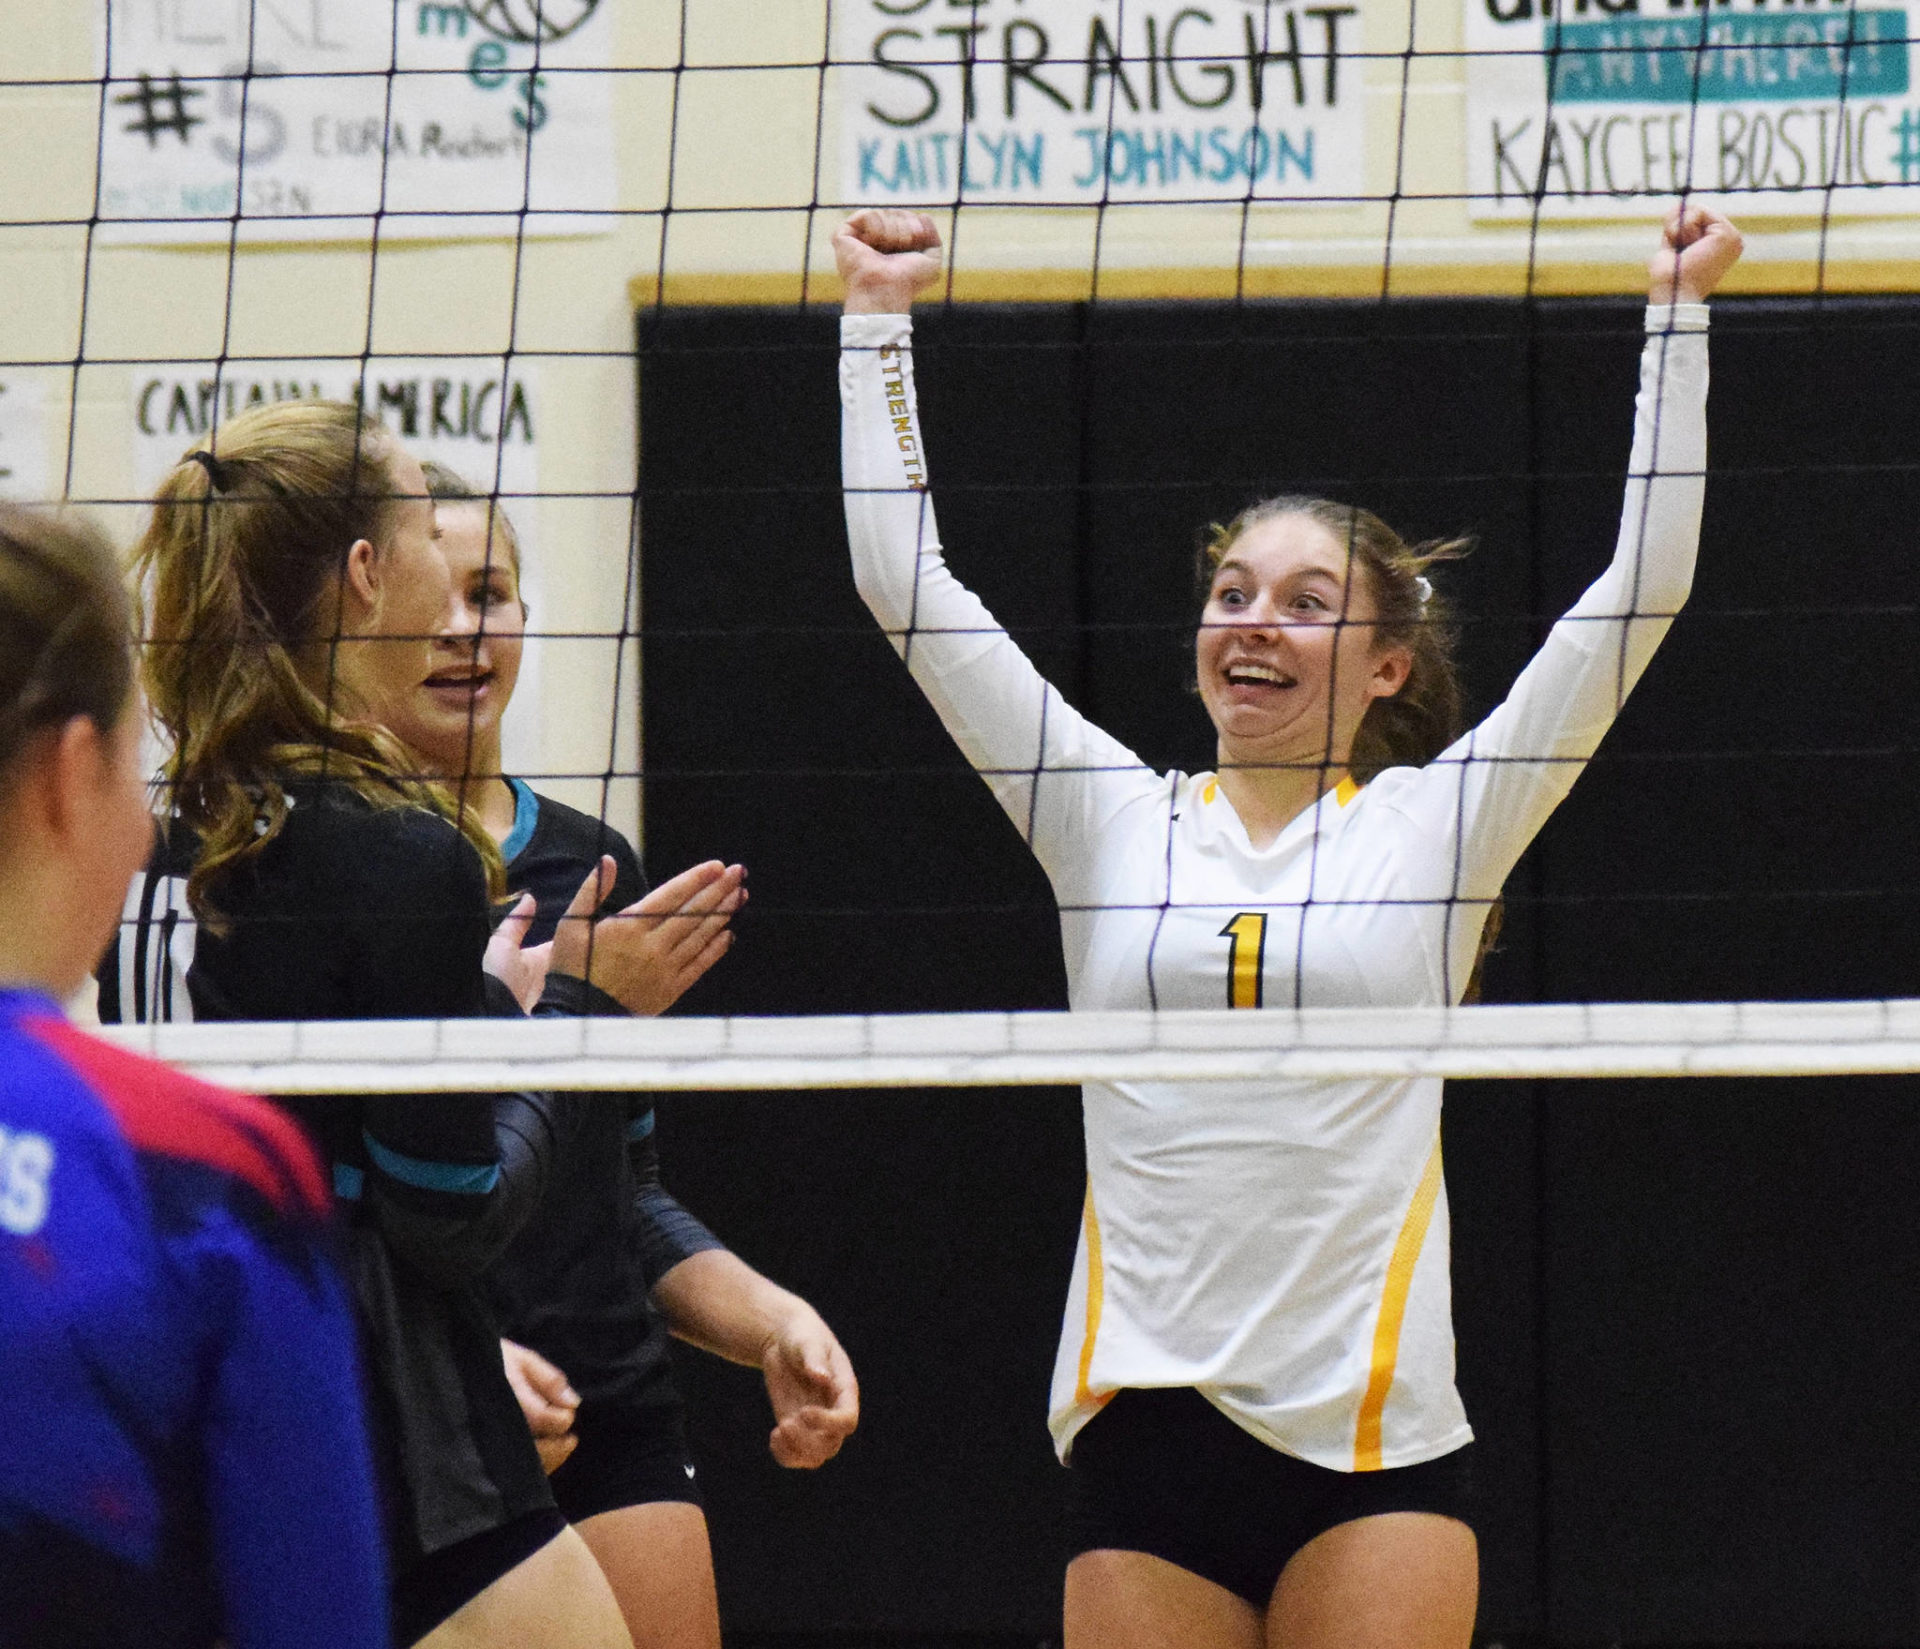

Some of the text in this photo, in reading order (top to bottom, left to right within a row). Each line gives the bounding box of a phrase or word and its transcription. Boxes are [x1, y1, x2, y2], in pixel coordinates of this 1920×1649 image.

[867, 6, 1358, 127] STRAIGHT
[857, 123, 1316, 193] KAITLYN JOHNSON
[1491, 112, 1687, 205] KAYCEE
[1717, 104, 1887, 194] BOSTIC
[878, 342, 928, 491] STRENGTH
[1217, 912, 1268, 1010] 1
